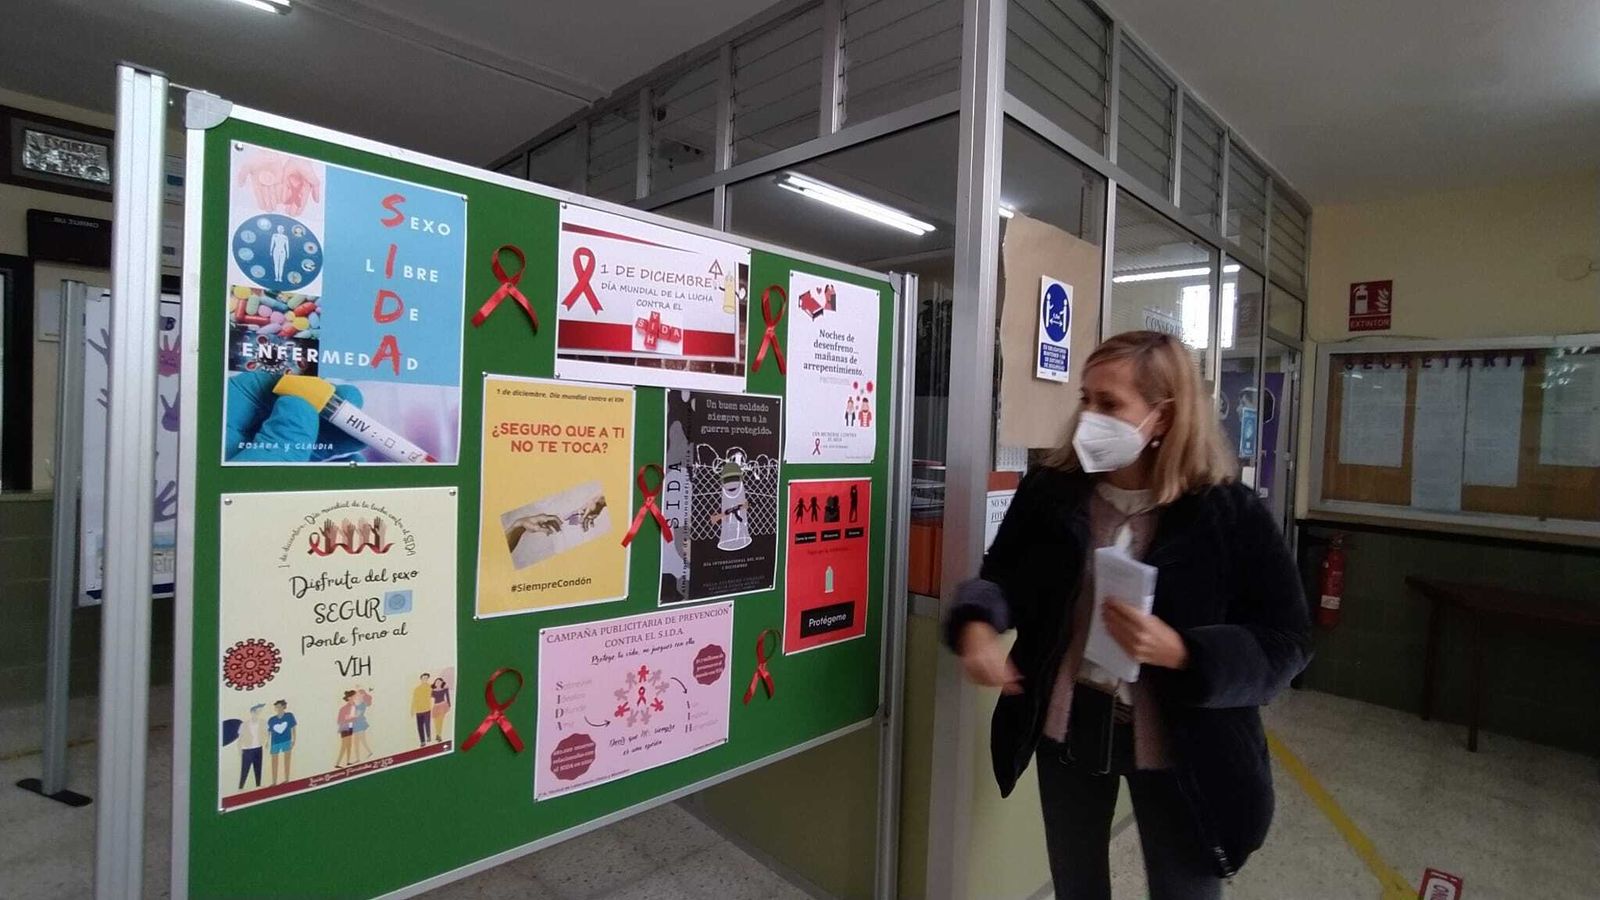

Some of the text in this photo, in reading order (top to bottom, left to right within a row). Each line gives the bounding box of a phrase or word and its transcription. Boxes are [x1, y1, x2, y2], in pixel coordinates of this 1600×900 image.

[600, 263, 609, 274] 1
[616, 264, 635, 278] DE
[601, 281, 713, 303] DÍA MUNDIAL DE LA LUCHA
[636, 298, 683, 311] CONTRA EL
[1350, 319, 1390, 330] EXTINTOR
[819, 329, 855, 342] Noches de
[814, 351, 858, 365] mañanas de
[502, 388, 511, 396] de
[706, 399, 769, 412] Un buen soldado
[345, 414, 370, 434] HIV
[707, 413, 740, 424] siempre
[758, 415, 767, 424] la
[492, 422, 625, 439] ¿SEGURO QUE A TI
[701, 425, 772, 437] guerra protegido.
[511, 440, 609, 454] NO TE TOCA?
[666, 462, 681, 529] SIDA
[991, 498, 1009, 507] NO SE
[289, 569, 419, 598] Disfruta del sexo
[511, 577, 592, 593] #SiempreCondón
[808, 612, 847, 628] Protégeme
[351, 627, 388, 646] freno
[392, 622, 408, 638] al
[546, 628, 598, 644] CAMPAÑA
[600, 616, 663, 636] PUBLICITARIA
[665, 615, 676, 624] DE
[604, 634, 643, 649] CONTRA
[645, 631, 656, 641] EL
[335, 655, 372, 678] VIH
